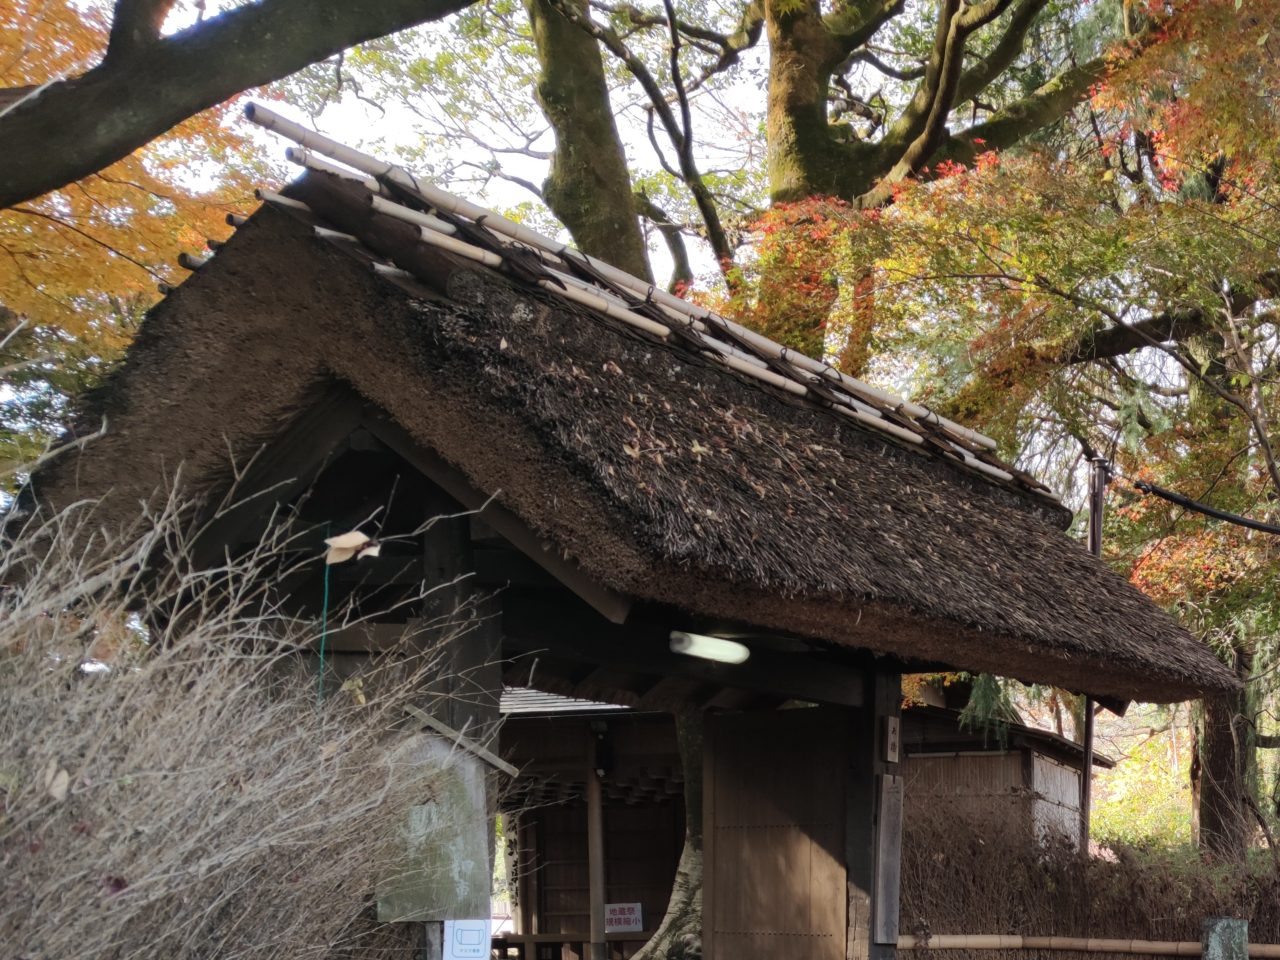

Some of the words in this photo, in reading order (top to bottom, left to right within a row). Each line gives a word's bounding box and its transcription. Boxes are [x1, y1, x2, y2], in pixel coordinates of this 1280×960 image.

[609, 907, 636, 916] 地蔵祭
[606, 917, 641, 927] 規模縮小
